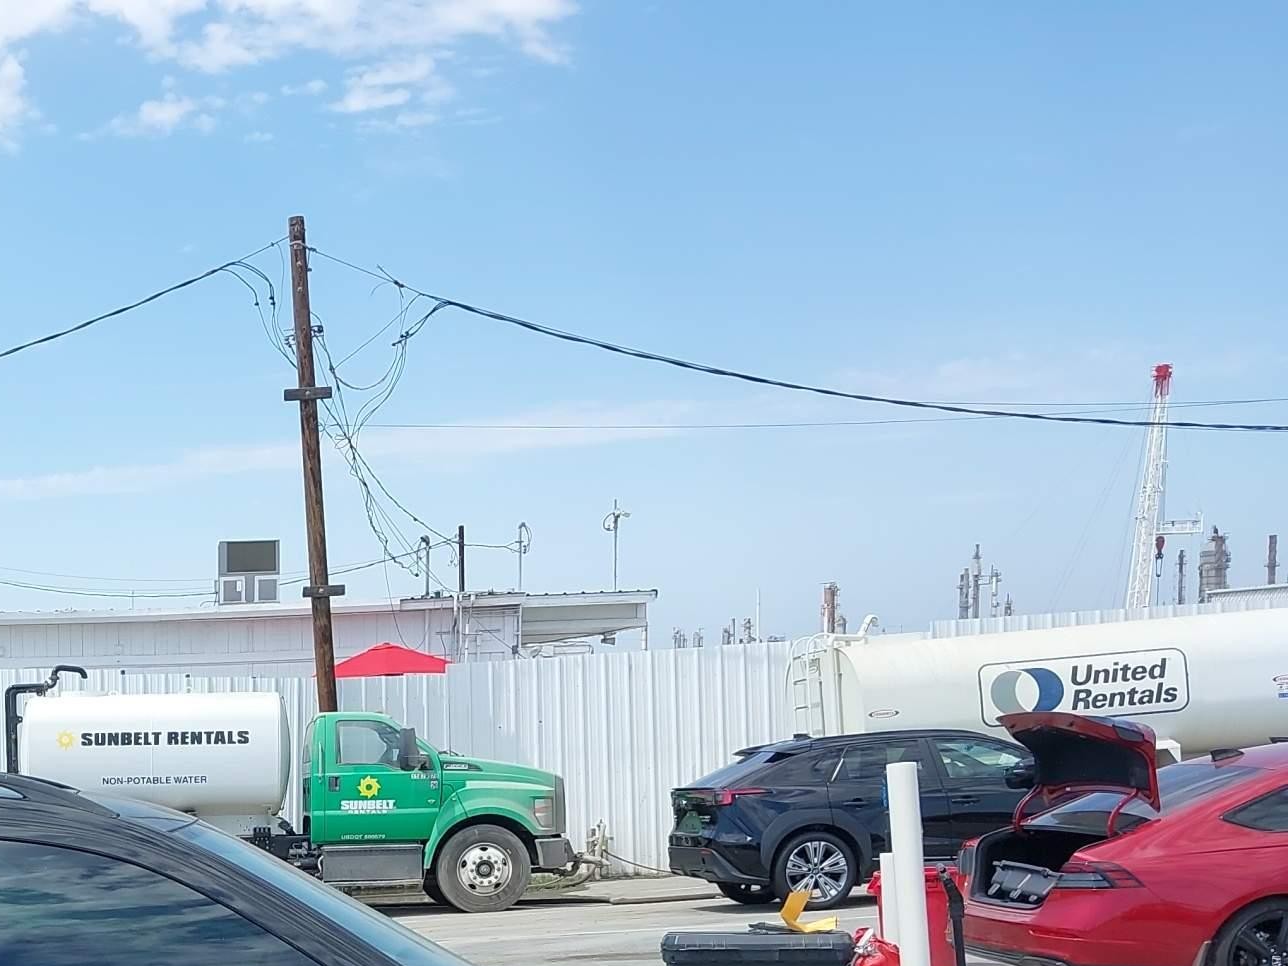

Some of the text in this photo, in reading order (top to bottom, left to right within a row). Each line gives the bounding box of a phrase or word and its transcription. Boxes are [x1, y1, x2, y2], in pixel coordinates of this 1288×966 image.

[1070, 657, 1167, 687] United
[1071, 682, 1178, 711] Rentals
[80, 730, 250, 747] SUNBELT RENTALS
[102, 775, 208, 786] NON-POTABLE WATER
[340, 799, 397, 811] SUNBELT
